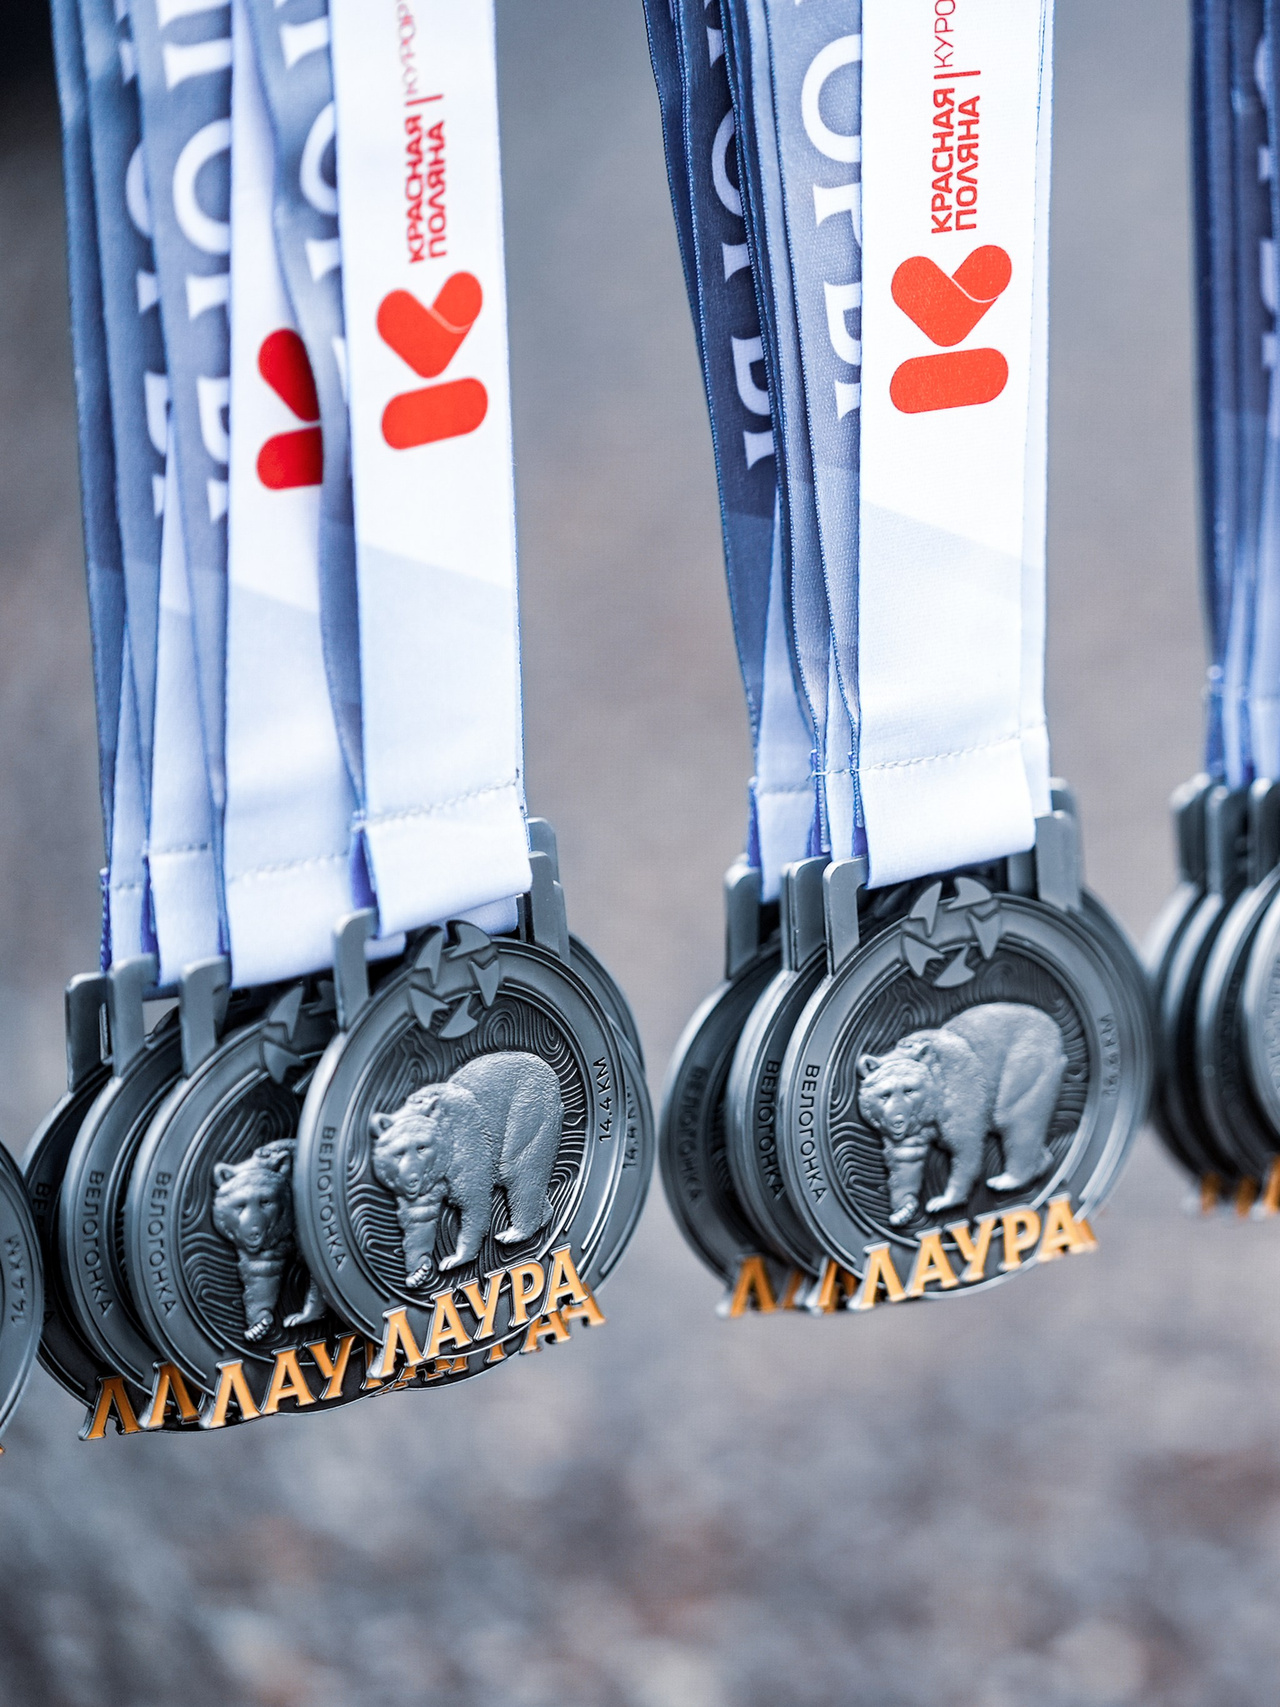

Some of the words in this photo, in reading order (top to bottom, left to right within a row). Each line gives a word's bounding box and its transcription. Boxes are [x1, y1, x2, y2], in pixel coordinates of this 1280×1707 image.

[404, 113, 425, 264] КРАСНАЯ
[426, 119, 448, 259] ПОЛЯНА
[930, 87, 956, 234] КРАСНАЯ
[955, 95, 981, 231] ПОЛЯНА
[598, 1097, 613, 1143] 14.4
[757, 1060, 787, 1201] ВЕЛОГОНКА
[798, 1064, 828, 1205] ВЕЛОГОНКА
[82, 1169, 113, 1318] ВЕЛОГОНКА
[147, 1171, 177, 1319] ВЕЛОГОНКА
[316, 1125, 348, 1273] ВЕЛОГОНКА
[848, 1191, 1090, 1311] ЛАУРА
[199, 1330, 384, 1429] ЛАУ
[366, 1242, 589, 1379] ЛАУРА
